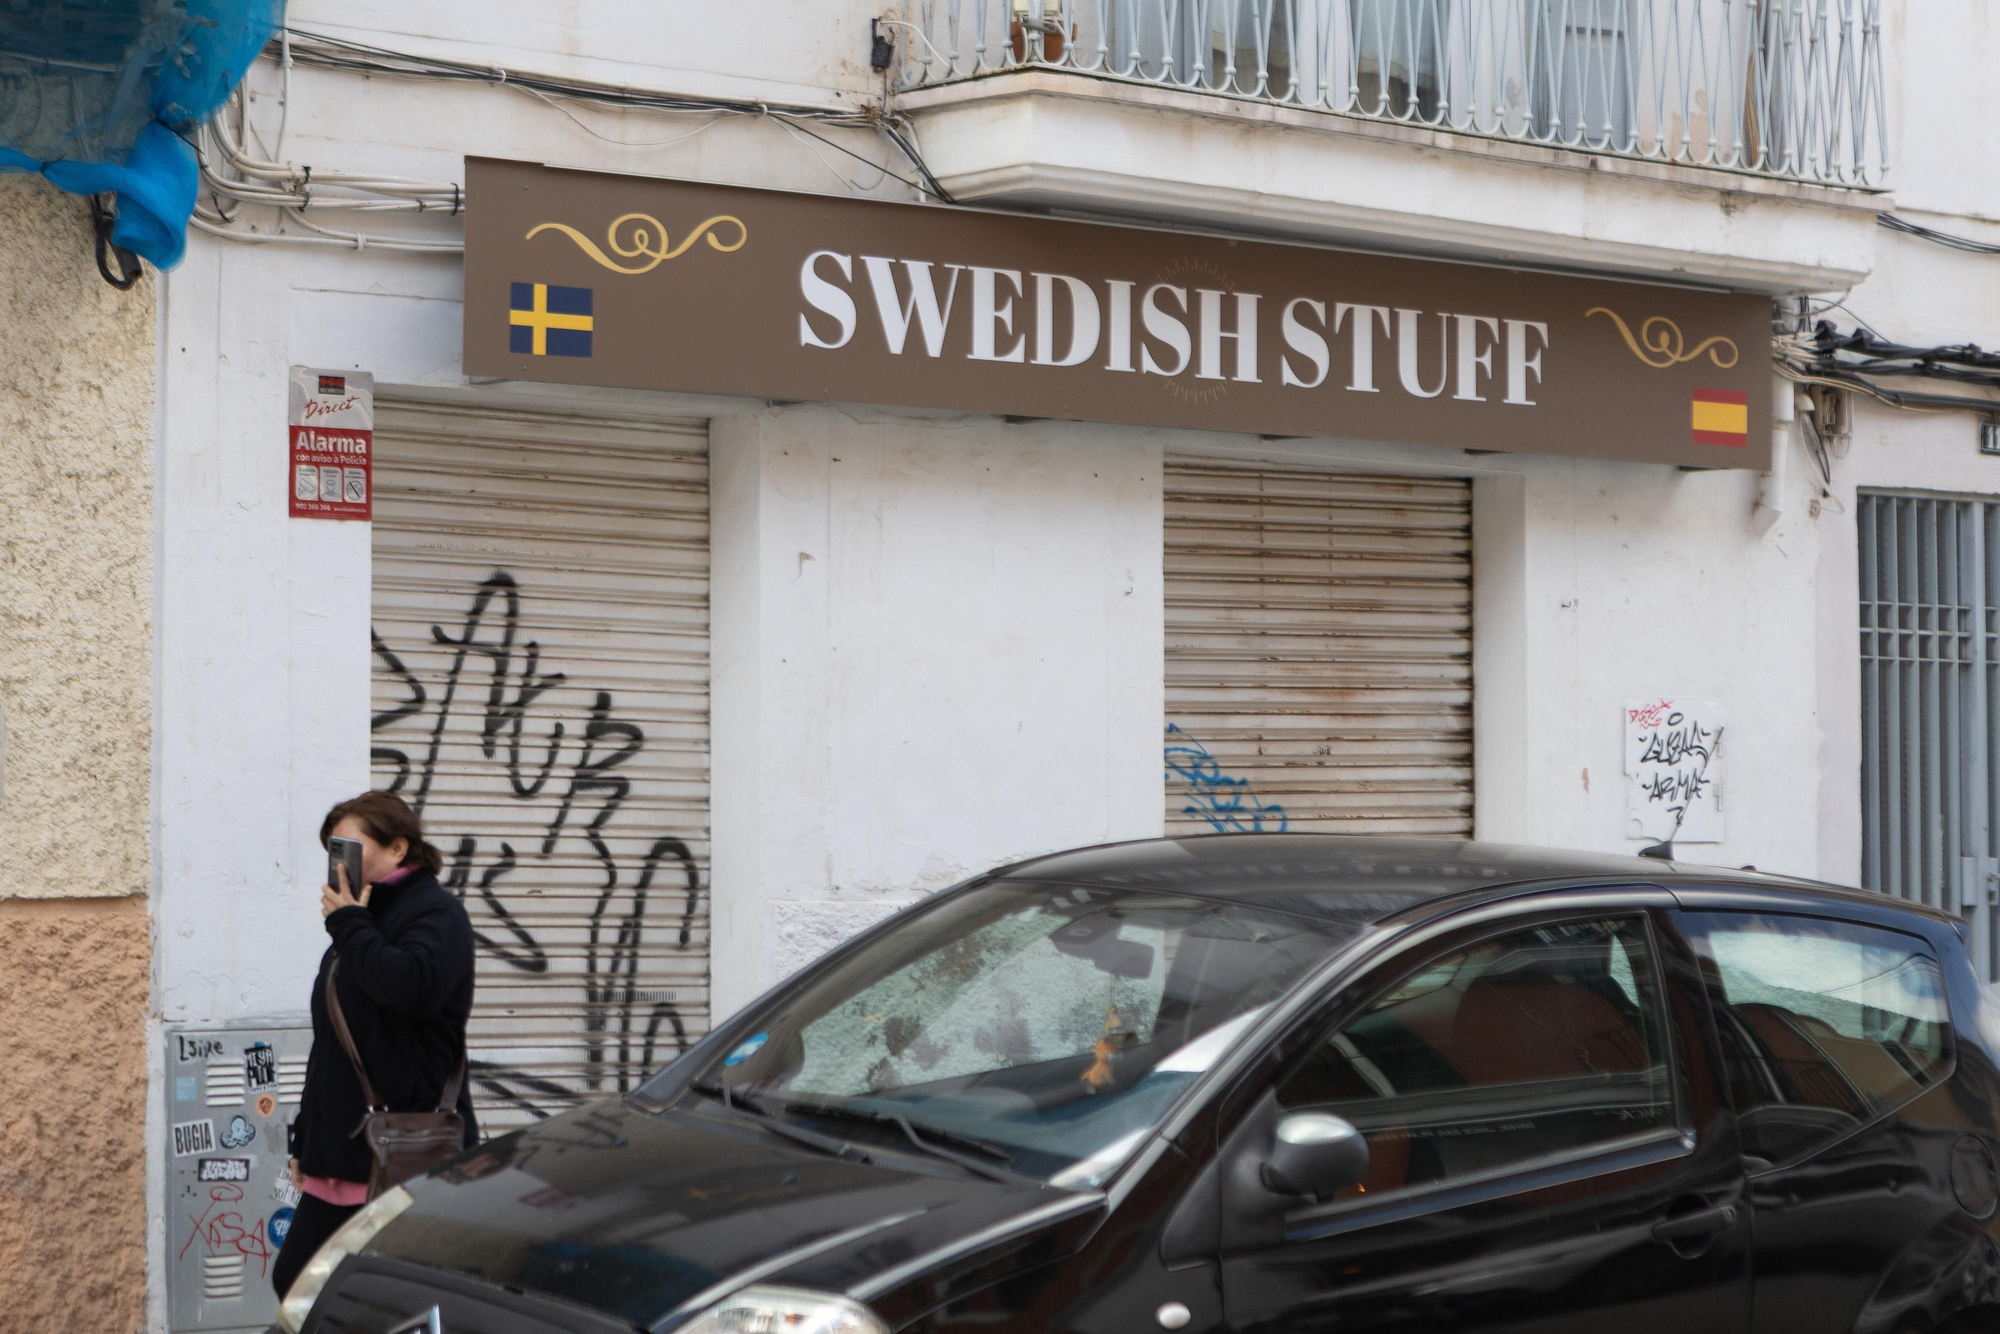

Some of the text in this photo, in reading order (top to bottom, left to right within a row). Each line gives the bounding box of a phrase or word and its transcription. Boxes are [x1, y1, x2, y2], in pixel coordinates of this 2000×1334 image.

[799, 249, 1550, 406] SWEDISH STUFF
[304, 395, 361, 420] Direct
[296, 431, 367, 455] Alarma
[295, 454, 310, 462] con
[311, 453, 333, 463] aviso
[174, 1121, 213, 1154] BUGIA
